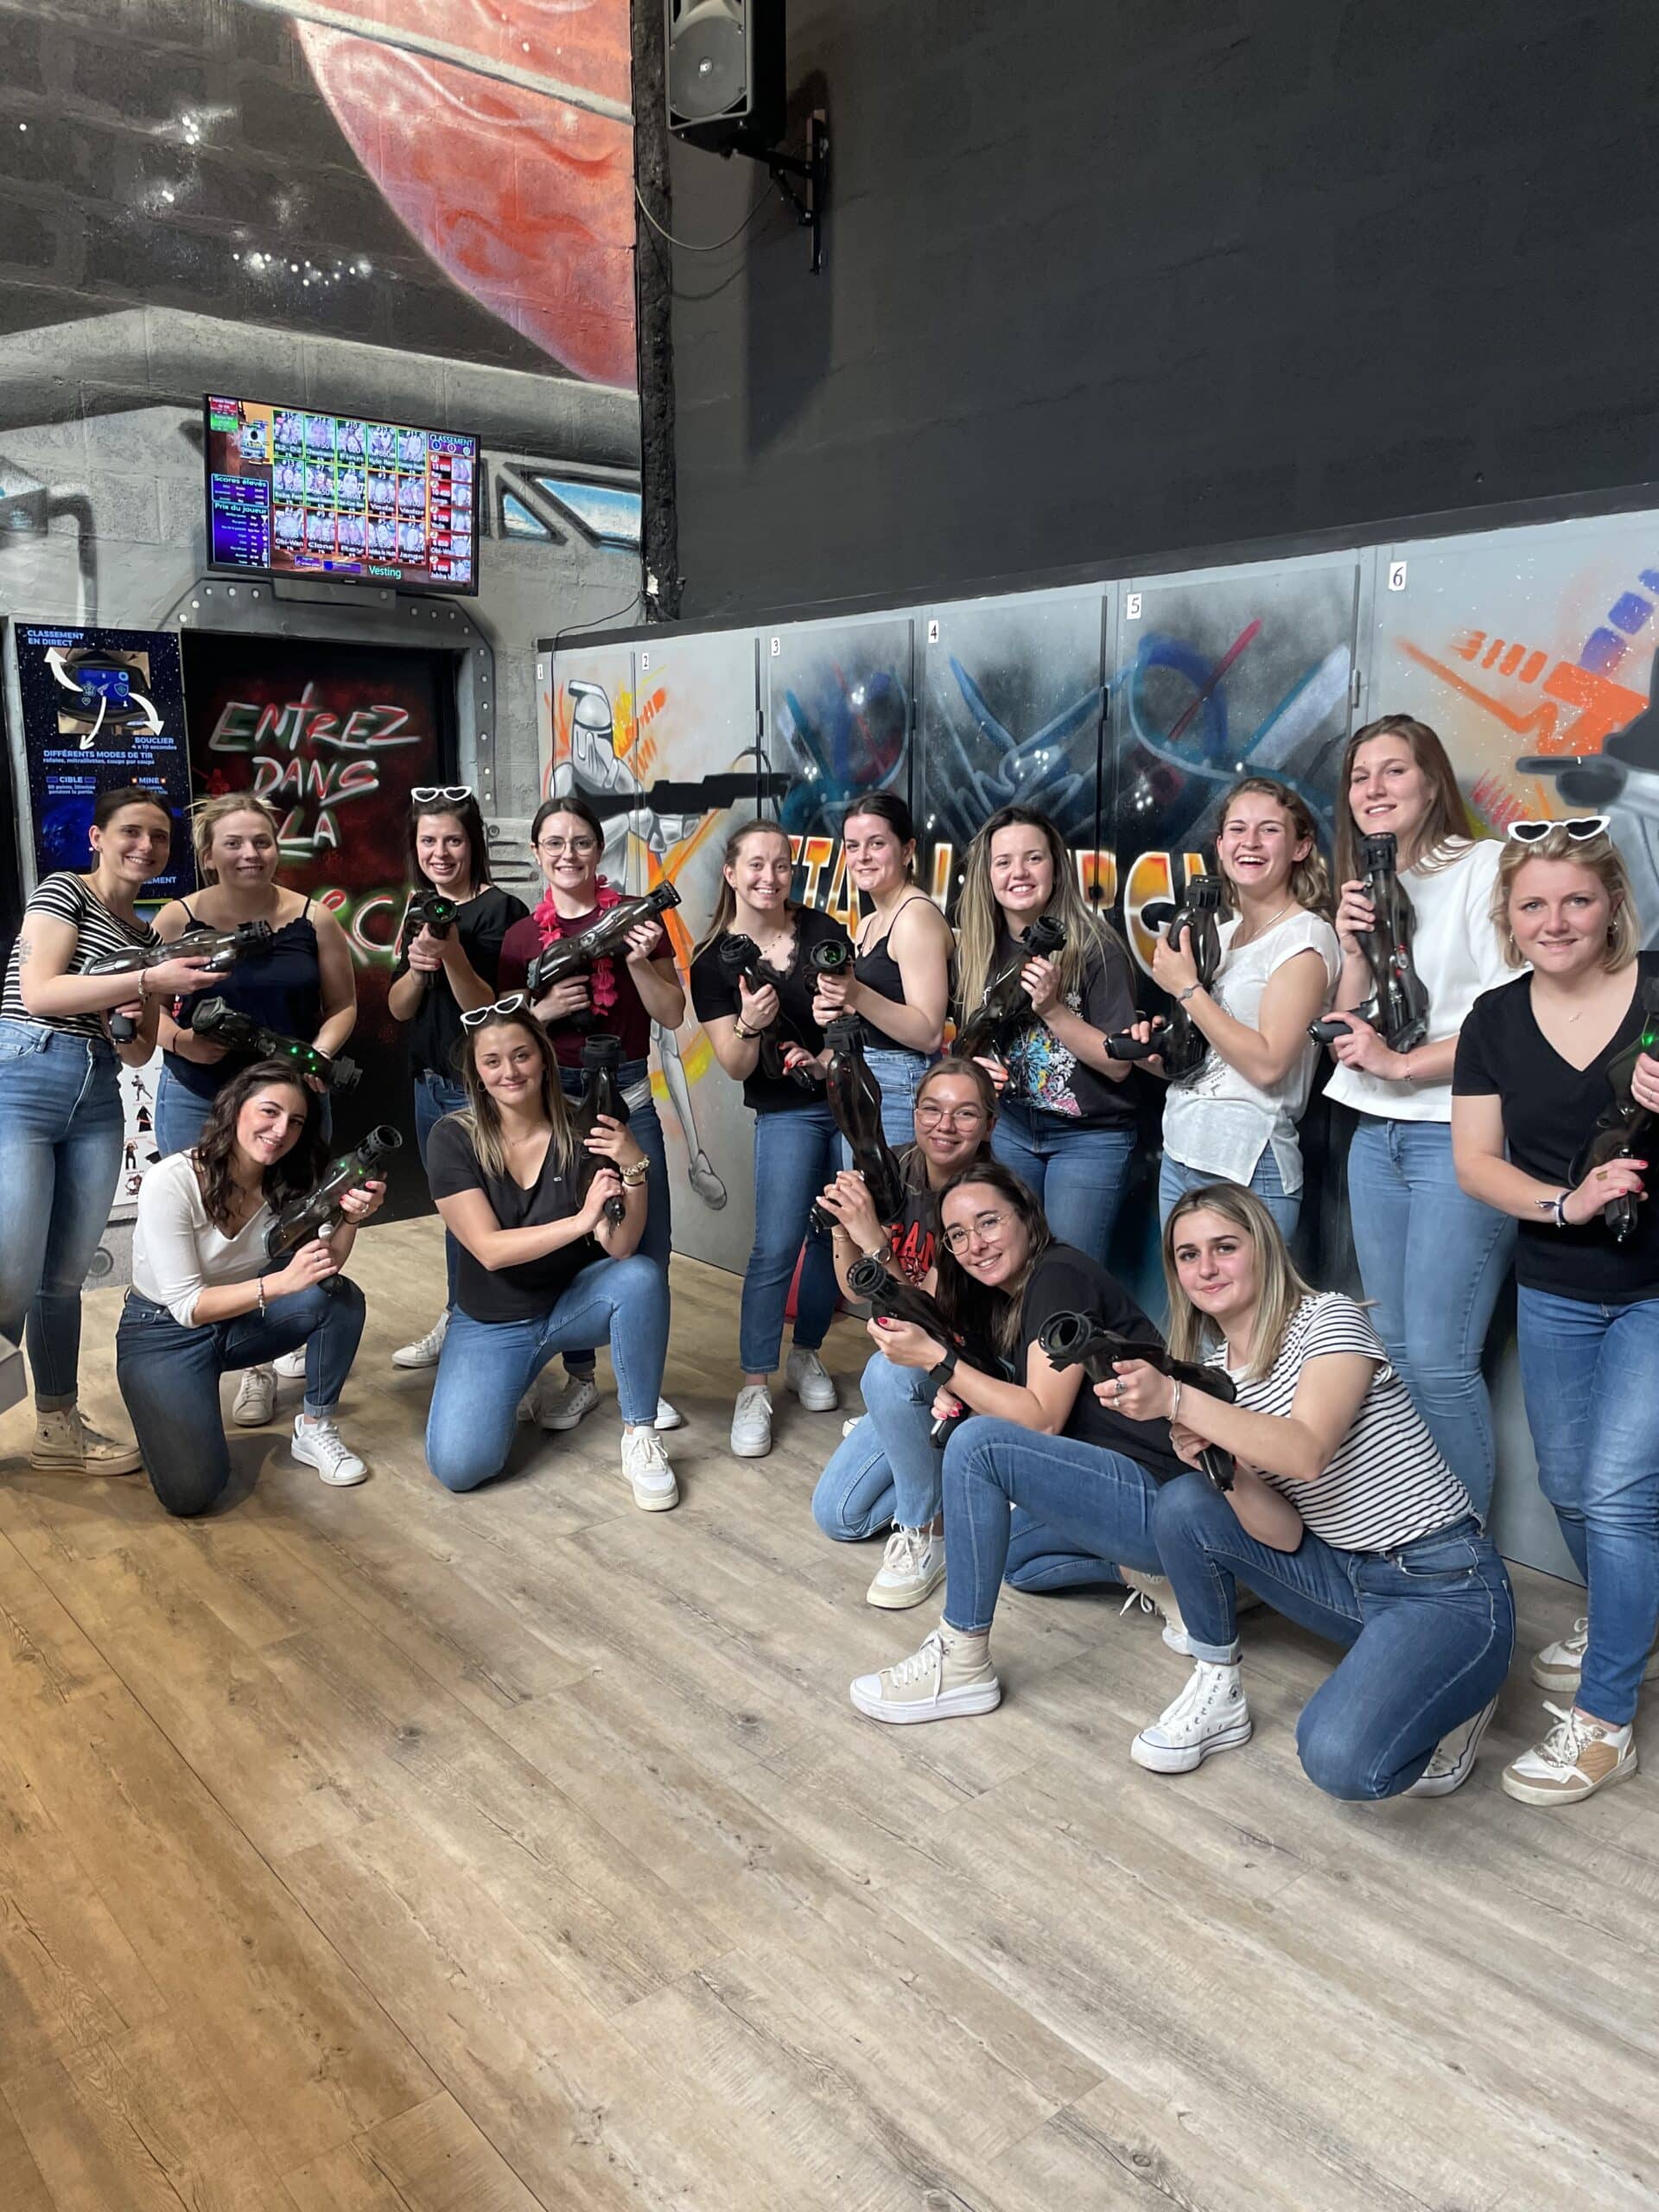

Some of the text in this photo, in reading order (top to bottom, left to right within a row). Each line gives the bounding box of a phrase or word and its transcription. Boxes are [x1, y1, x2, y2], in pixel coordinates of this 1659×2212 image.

[214, 474, 240, 484] Scores
[242, 505, 266, 514] joueur
[308, 542, 334, 550] Clone
[340, 544, 363, 554] Rey
[369, 564, 402, 580] Vesting
[1393, 566, 1403, 587] 6
[1130, 597, 1140, 614] 5
[27, 629, 85, 639] CLASSEMENT
[930, 624, 938, 640] 4
[772, 639, 779, 654] 3
[209, 682, 422, 751] ENTREZ
[134, 736, 175, 745] BOUCLIER
[43, 749, 95, 758] DIFFÉRENTS
[251, 756, 380, 807] DANS
[276, 810, 338, 849] LA
